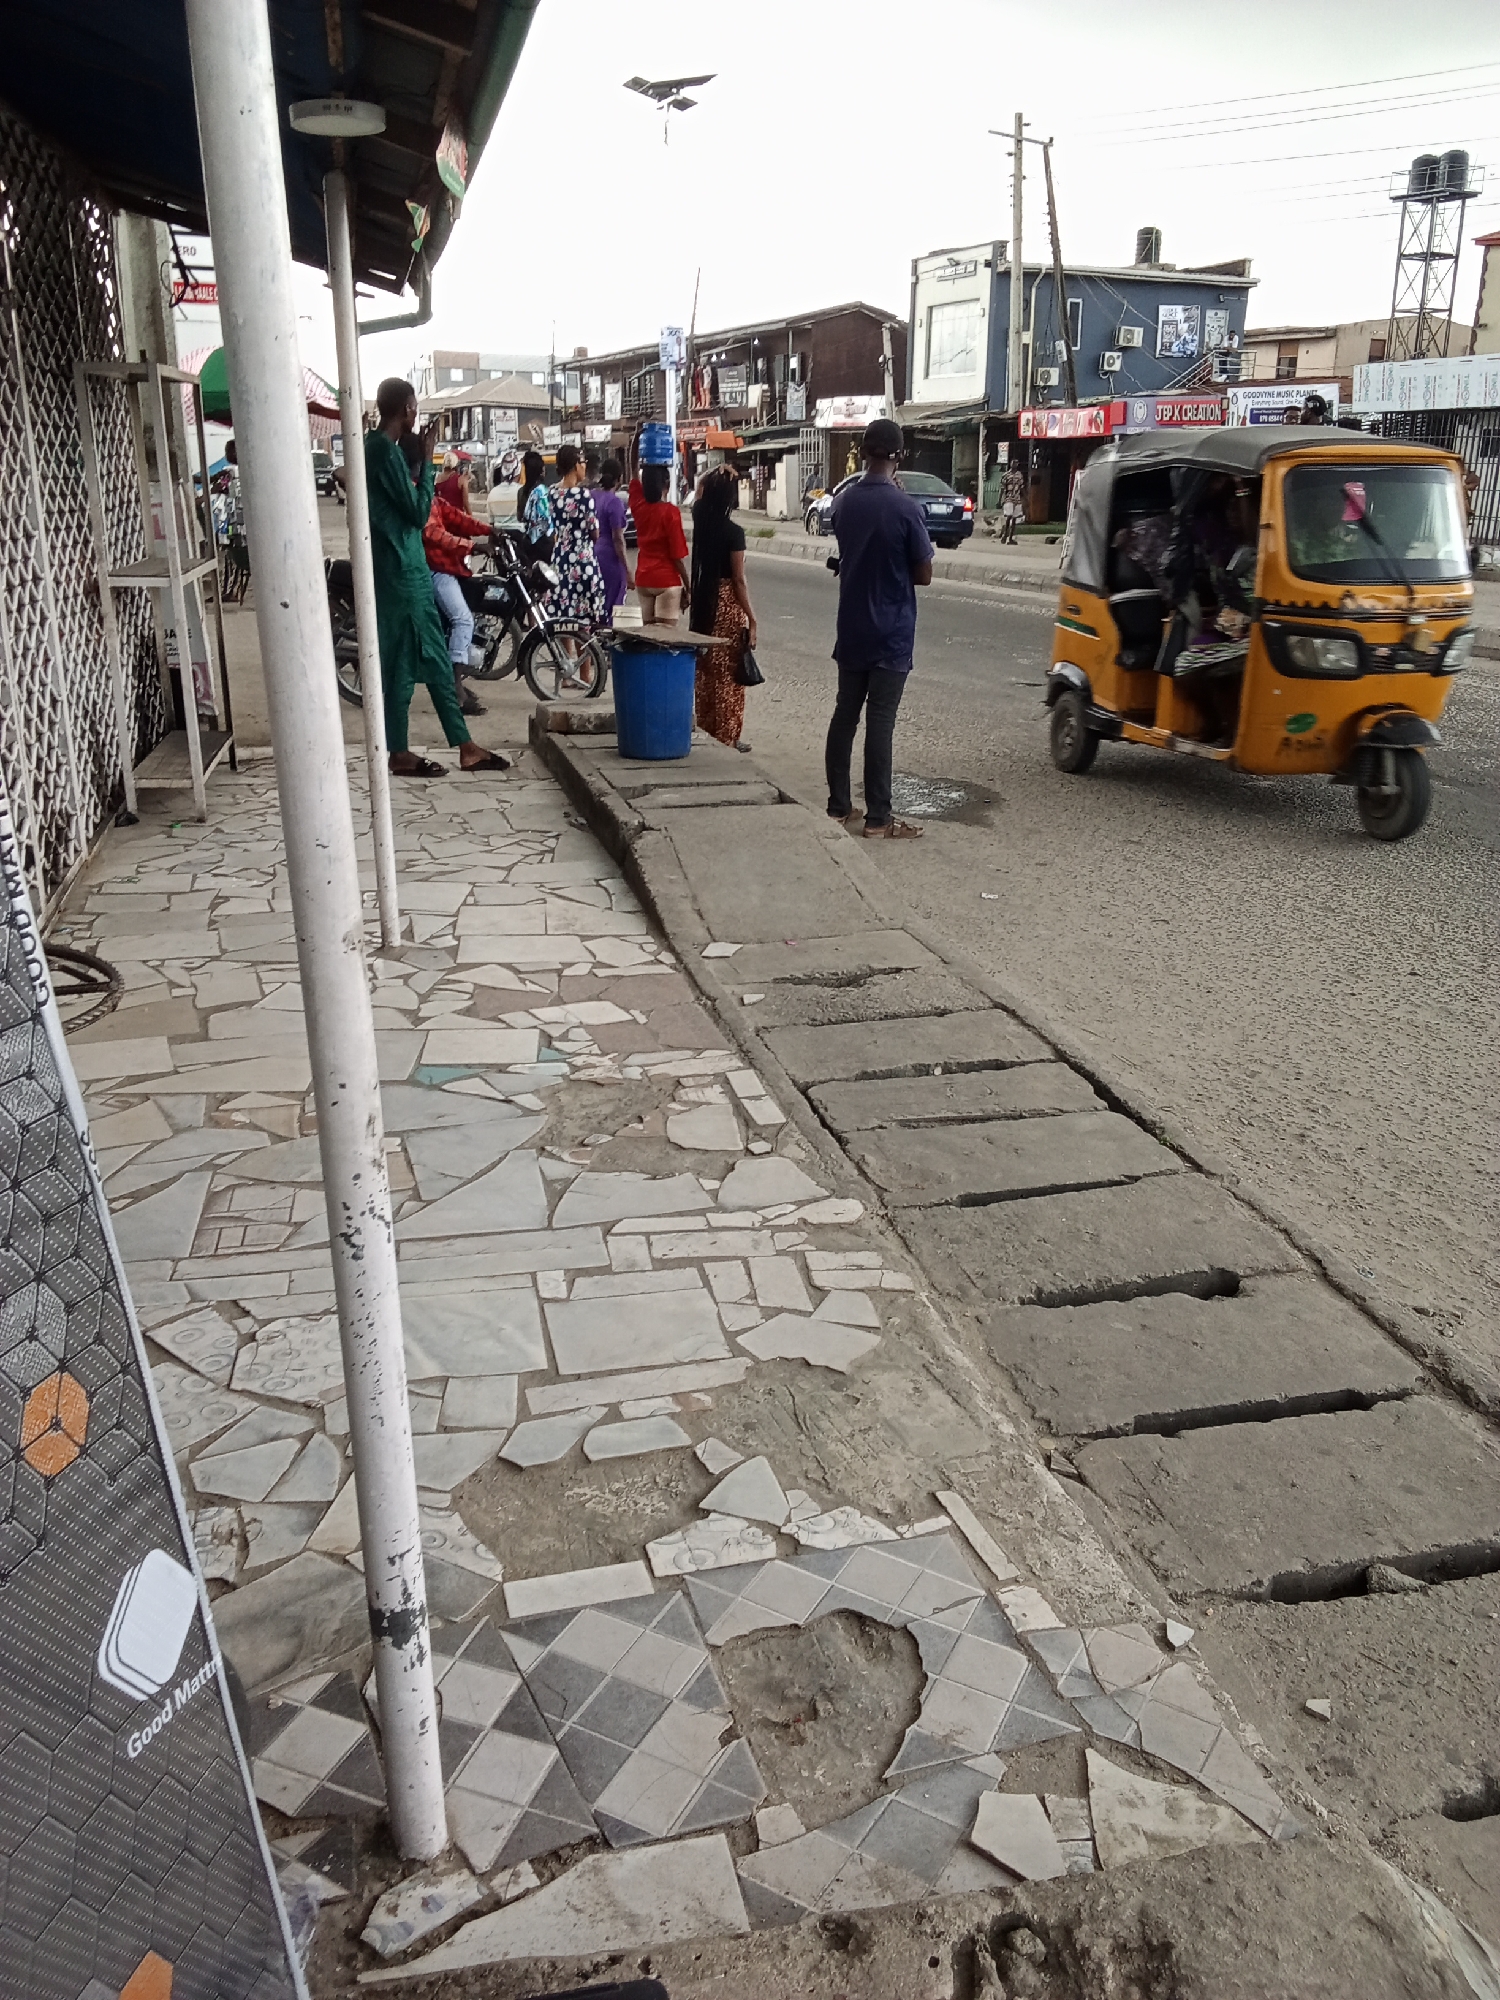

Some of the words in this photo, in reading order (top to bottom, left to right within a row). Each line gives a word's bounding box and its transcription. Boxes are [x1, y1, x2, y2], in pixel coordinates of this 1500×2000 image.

[1276, 389, 1295, 398] MUSIC
[1182, 404, 1221, 421] CREATION
[126, 1698, 173, 1758] Good
